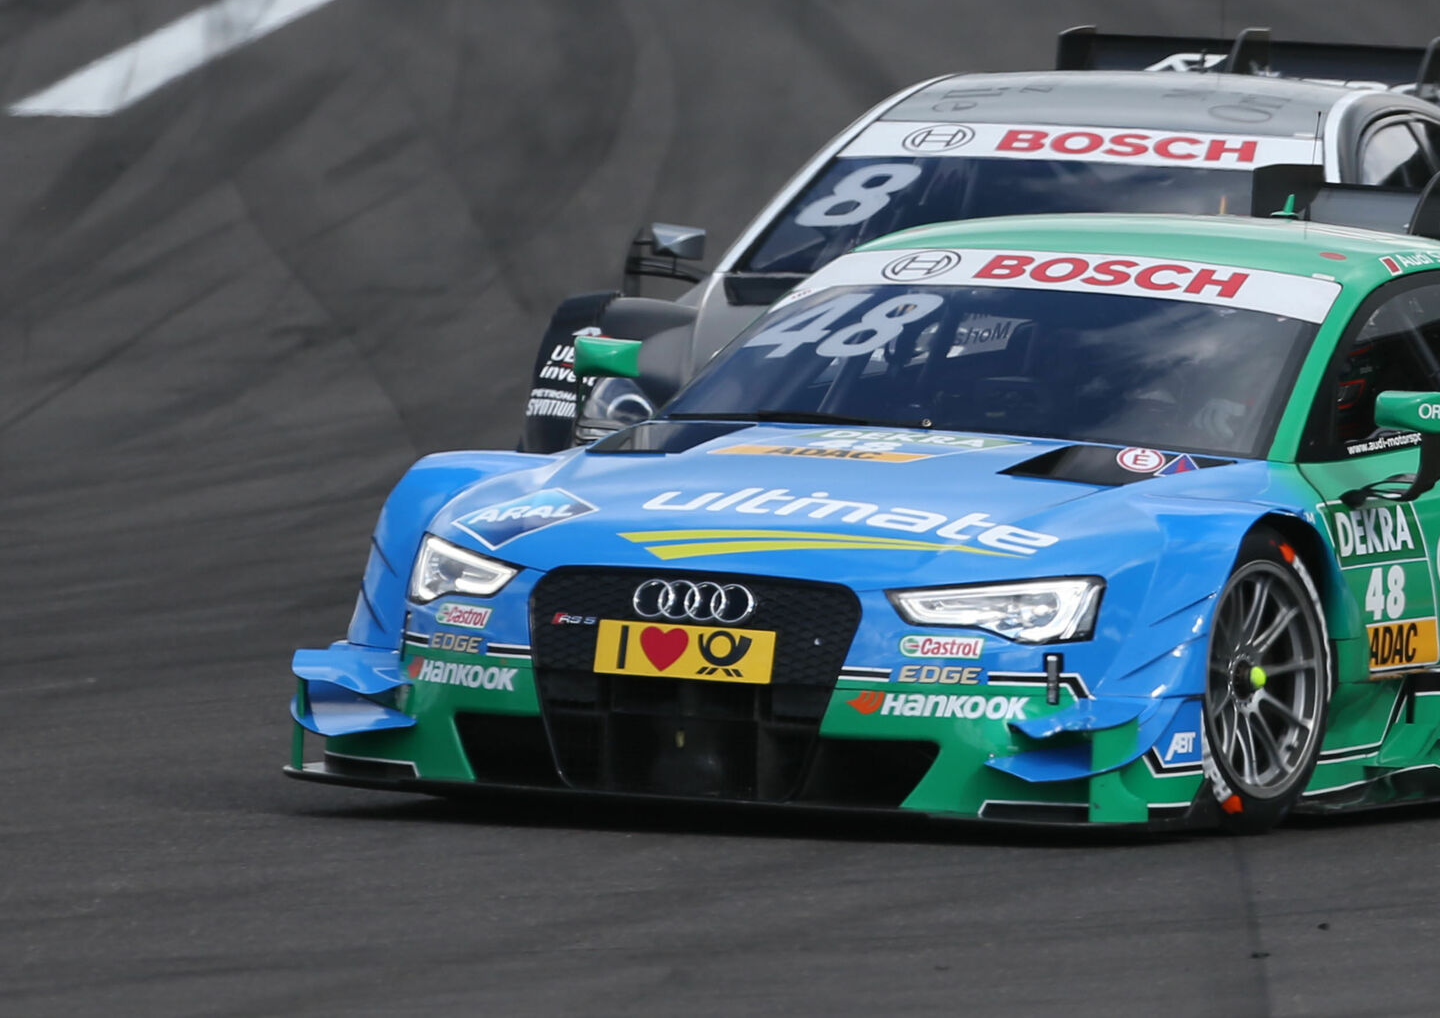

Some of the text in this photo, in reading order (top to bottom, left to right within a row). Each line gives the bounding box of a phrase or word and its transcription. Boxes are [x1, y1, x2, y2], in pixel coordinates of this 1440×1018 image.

[994, 129, 1260, 164] BOSCH
[795, 163, 922, 228] 8
[1395, 251, 1434, 269] Audi
[971, 254, 1251, 299] BOSCH
[742, 293, 945, 359] 48
[765, 446, 883, 460] ADAC
[820, 430, 986, 448] DEKRA
[468, 503, 574, 525] ARAL
[641, 487, 1060, 557] ultimate
[1334, 503, 1415, 558] DEKRA
[1364, 564, 1406, 621] 48
[446, 604, 490, 628] Castrol
[430, 632, 484, 654] EDGE
[615, 624, 630, 670] I
[920, 637, 981, 659] Castrol
[1369, 622, 1418, 665] ADAC
[897, 664, 983, 685] EDGE
[1164, 731, 1197, 761] ABT
